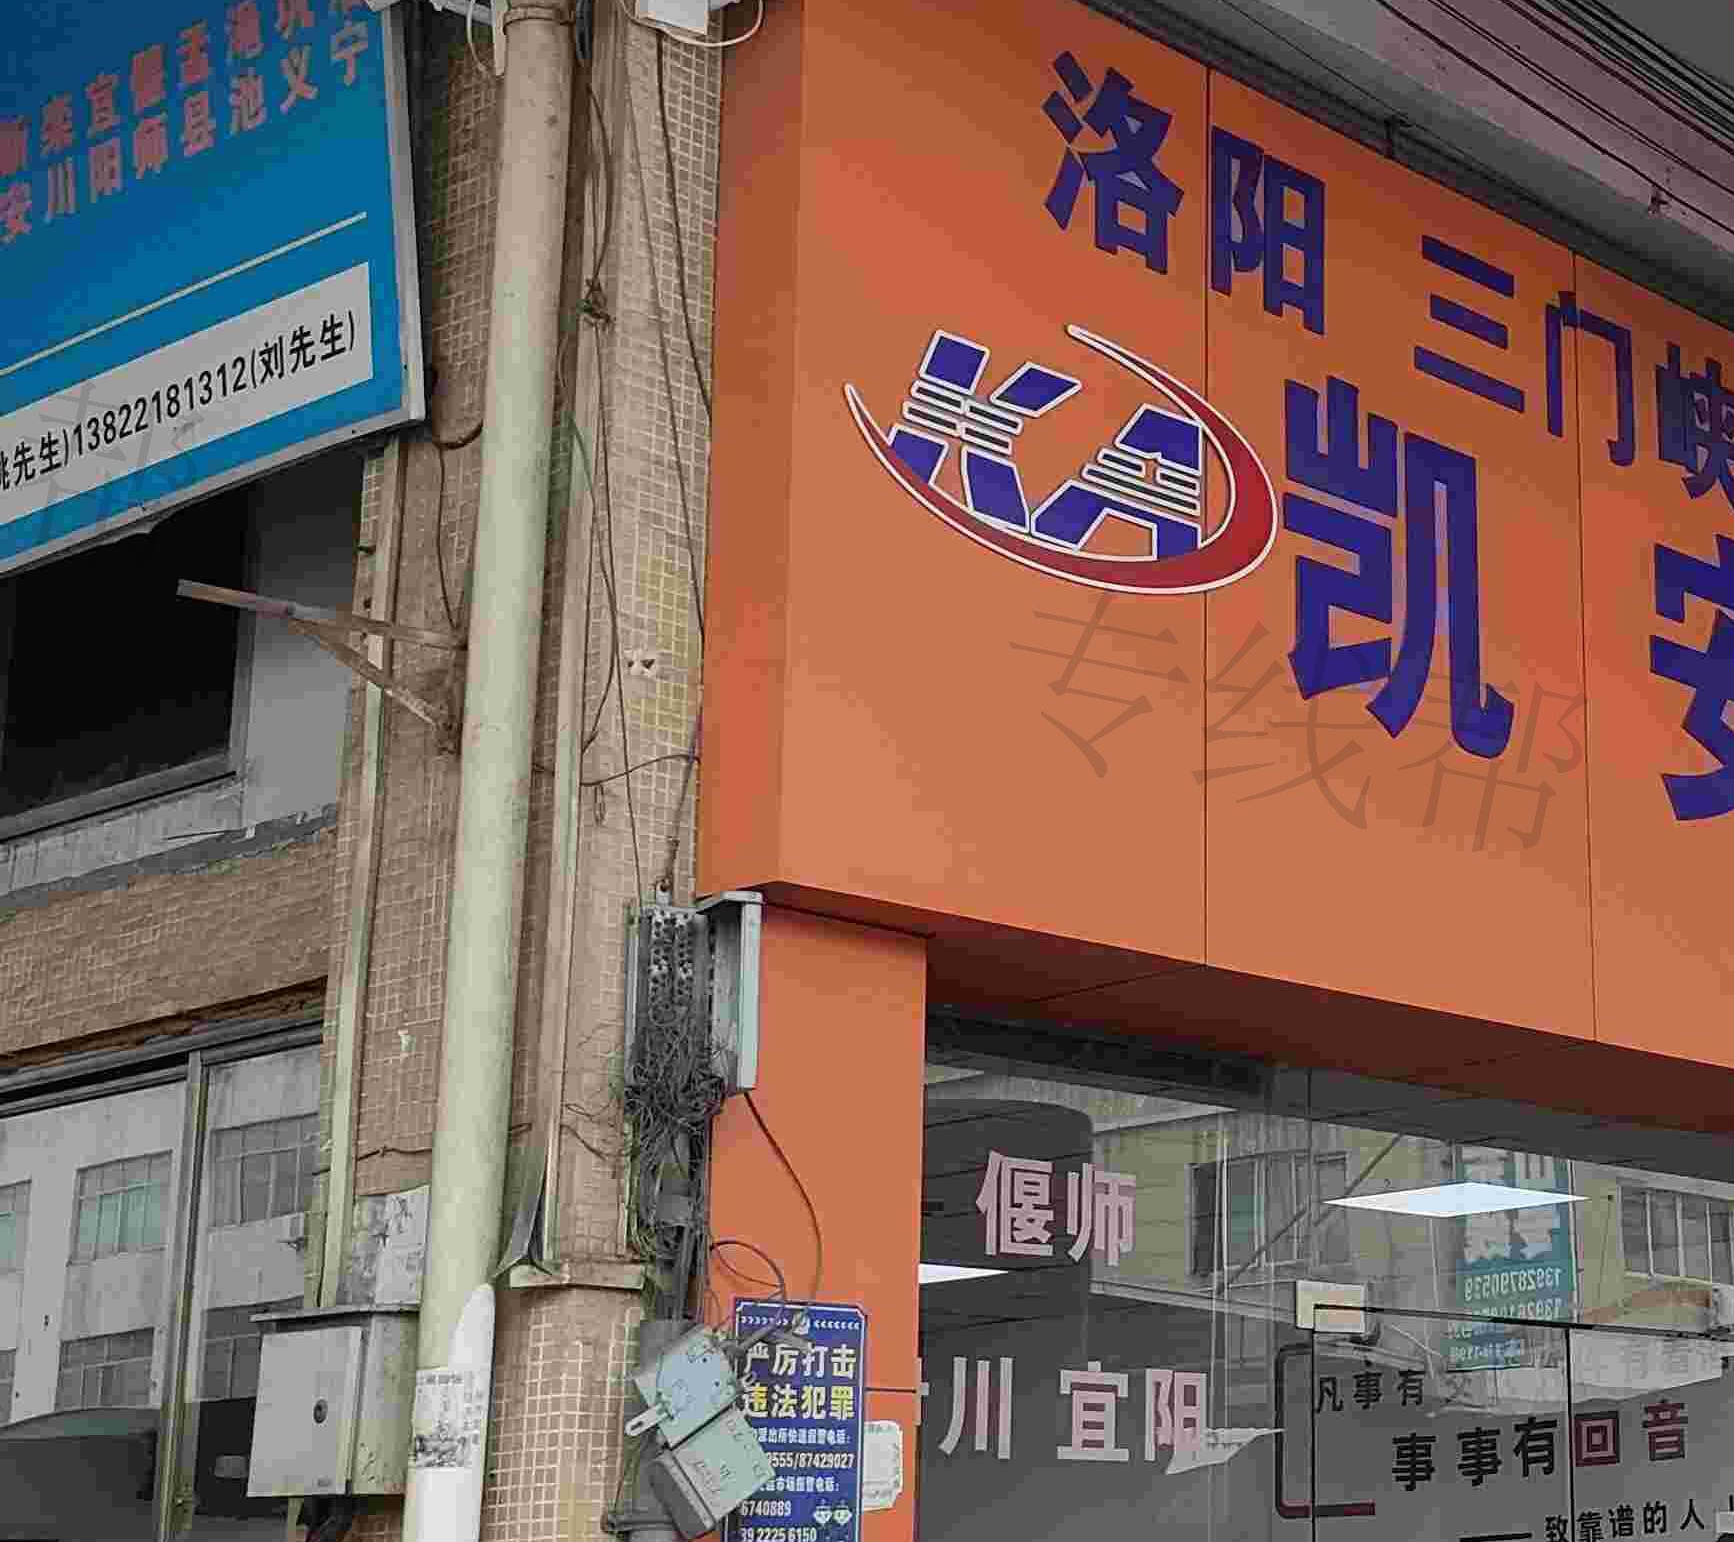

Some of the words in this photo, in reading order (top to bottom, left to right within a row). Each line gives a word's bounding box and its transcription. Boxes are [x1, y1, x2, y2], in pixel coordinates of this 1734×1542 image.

[1042, 50, 1326, 336] 洛阳
[976, 1151, 1137, 1267] 偃师
[743, 1384, 856, 1420] 违法犯罪
[744, 1342, 857, 1380] 严厉打击
[918, 1355, 1013, 1460] 川
[1056, 1361, 1210, 1465] 宜阳
[1391, 1400, 1689, 1492] 事事有回音
